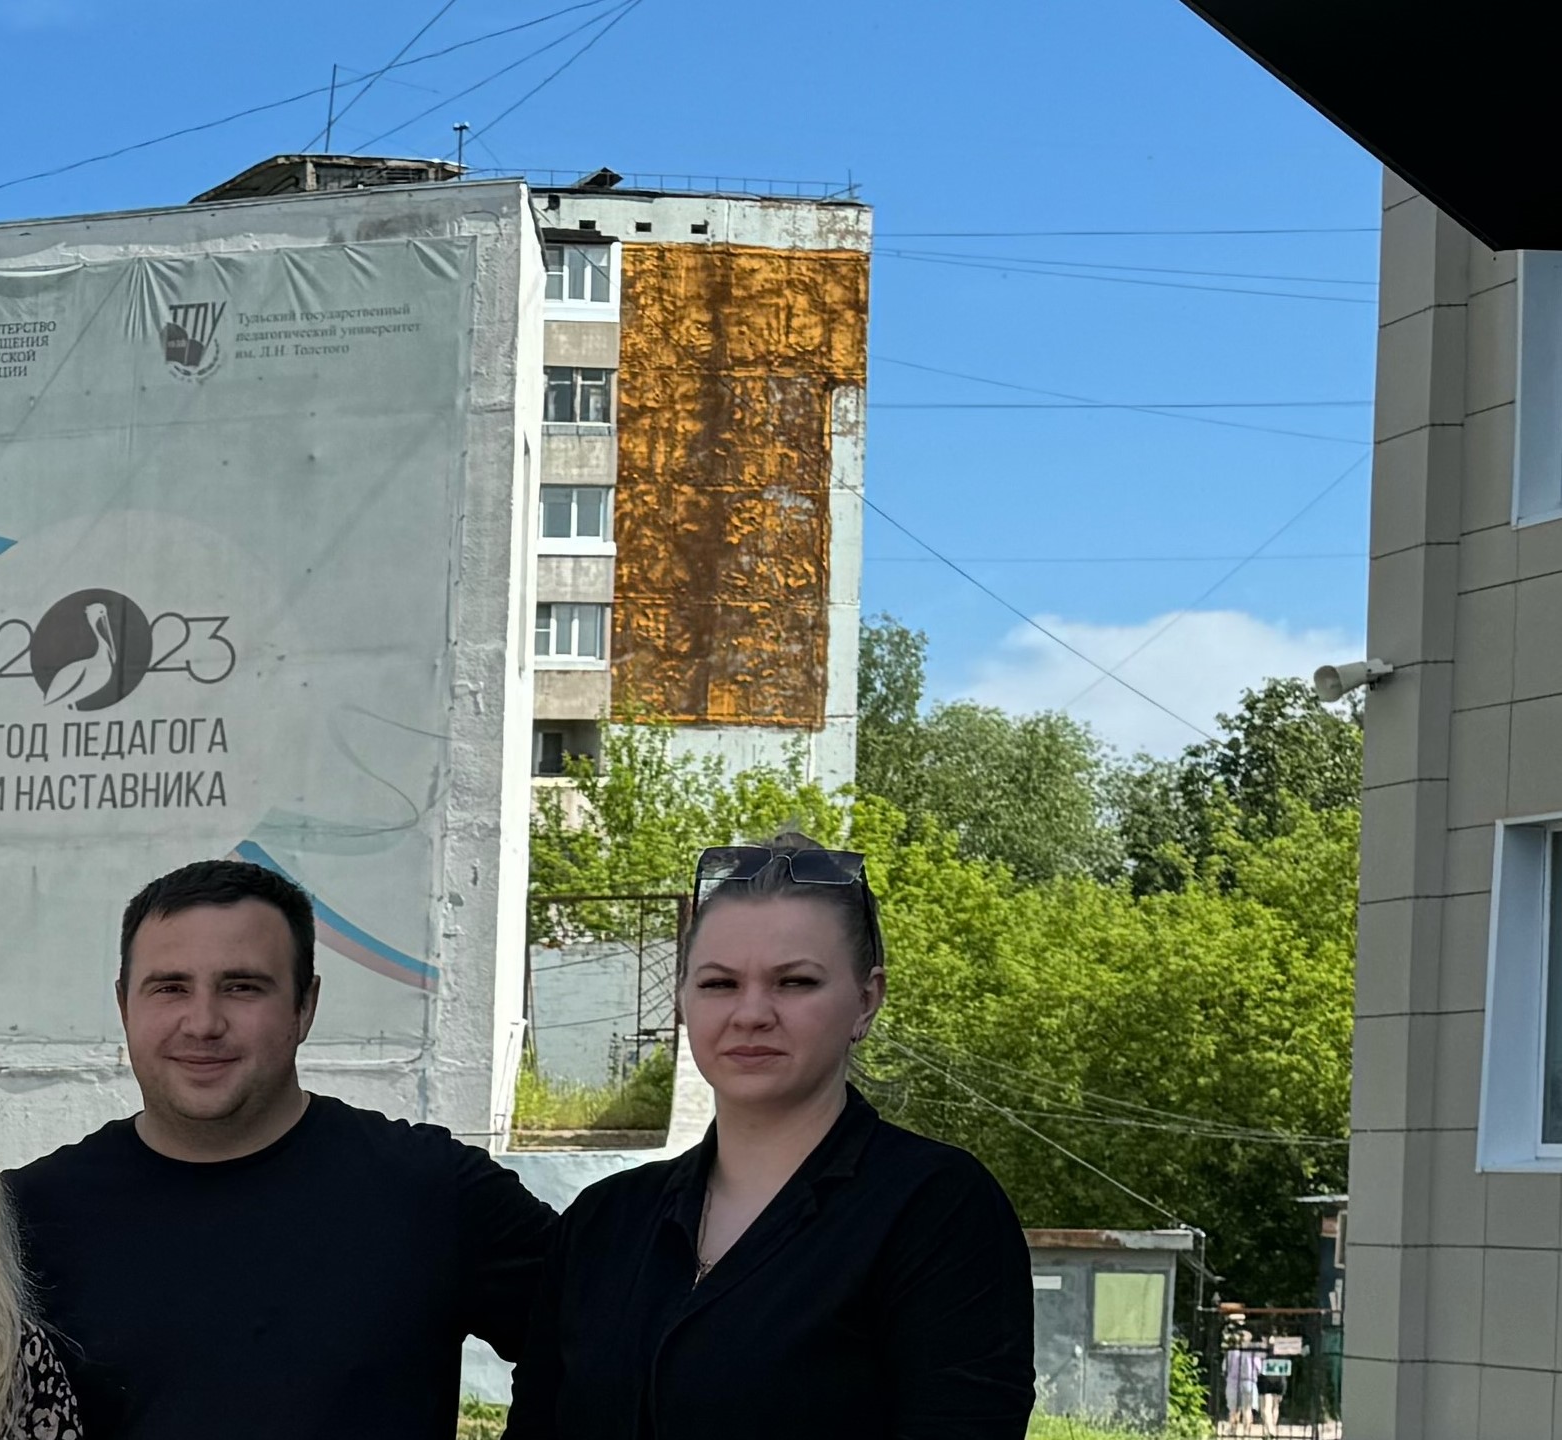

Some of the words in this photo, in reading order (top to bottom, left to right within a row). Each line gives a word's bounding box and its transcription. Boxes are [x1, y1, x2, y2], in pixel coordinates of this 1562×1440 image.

[237, 311, 296, 327] Тульский
[300, 304, 411, 322] государственный
[235, 325, 338, 342] педагогический
[340, 321, 422, 339] университет
[292, 343, 350, 357] Толстого
[62, 717, 228, 761] ПЕДАГОГА
[15, 770, 227, 812] НАСТАВНИКА
